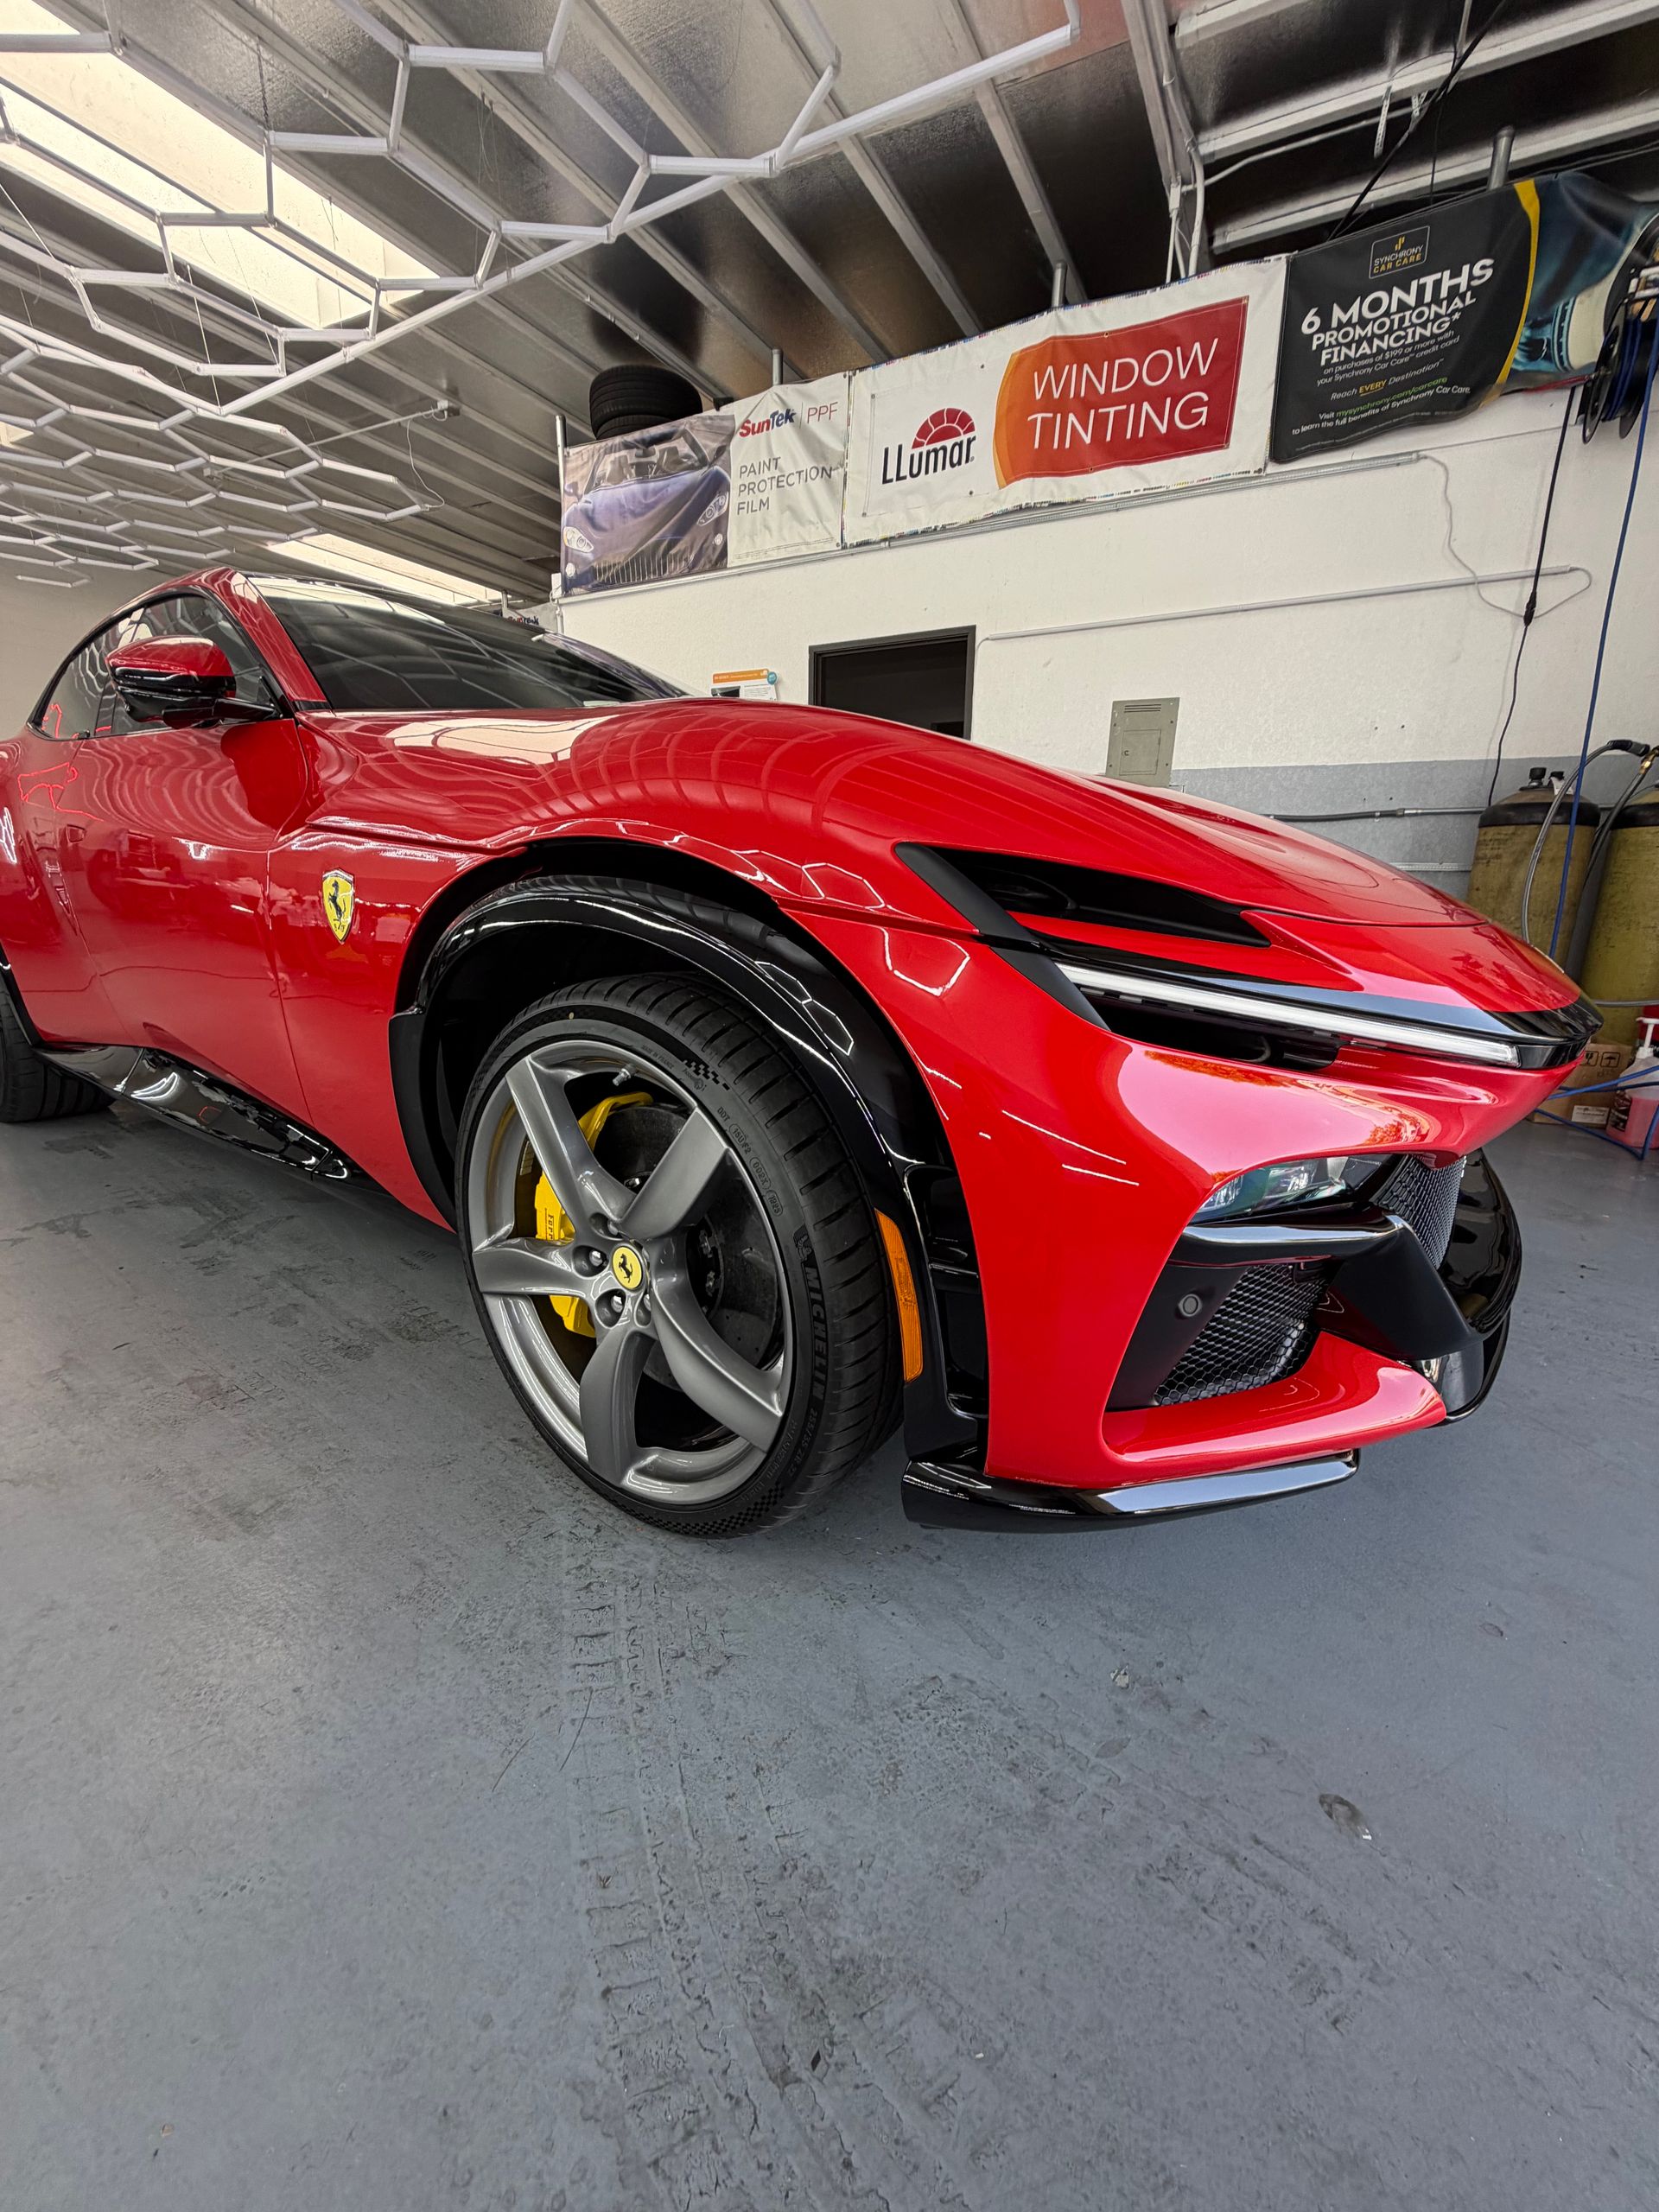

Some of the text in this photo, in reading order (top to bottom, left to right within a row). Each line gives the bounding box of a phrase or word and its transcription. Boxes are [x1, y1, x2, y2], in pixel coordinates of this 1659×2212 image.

[1373, 253, 1422, 274] CAR CARE
[1375, 245, 1424, 266] SYNCHRONY
[1301, 258, 1495, 335] 6 MONTHS
[1312, 290, 1477, 351] PROMOTIONAL
[1033, 338, 1220, 400] WINDOW
[1316, 376, 1333, 387] your
[1334, 364, 1374, 383] Synchrony
[1374, 361, 1389, 371] Car
[1415, 346, 1440, 359] credit
[1440, 335, 1459, 349] card
[1334, 357, 1374, 374] purchases
[1375, 353, 1383, 362] of
[1384, 348, 1403, 360] $199
[1414, 339, 1436, 351] more
[1437, 330, 1454, 342] with
[1301, 423, 1320, 432] learn
[1335, 416, 1347, 427] full
[1348, 408, 1380, 423] benefits
[1391, 389, 1434, 409] Synchrony
[1435, 385, 1451, 394] Car
[1319, 377, 1448, 420] Visit mysynchrony.com/carcare
[1331, 388, 1358, 401] Reach
[1359, 378, 1387, 394] EVERY
[739, 402, 838, 438] SunTek PPF
[1027, 391, 1210, 450] TINTING
[740, 456, 781, 479] PAINT
[882, 435, 976, 485] LLumar
[738, 466, 835, 496] PROTECTION
[737, 499, 770, 515] FILM
[717, 1106, 730, 1122] DOT
[804, 1267, 827, 1400] MICHELIN
[801, 1408, 817, 1448] 255/35
[793, 1448, 805, 1464] ZR
